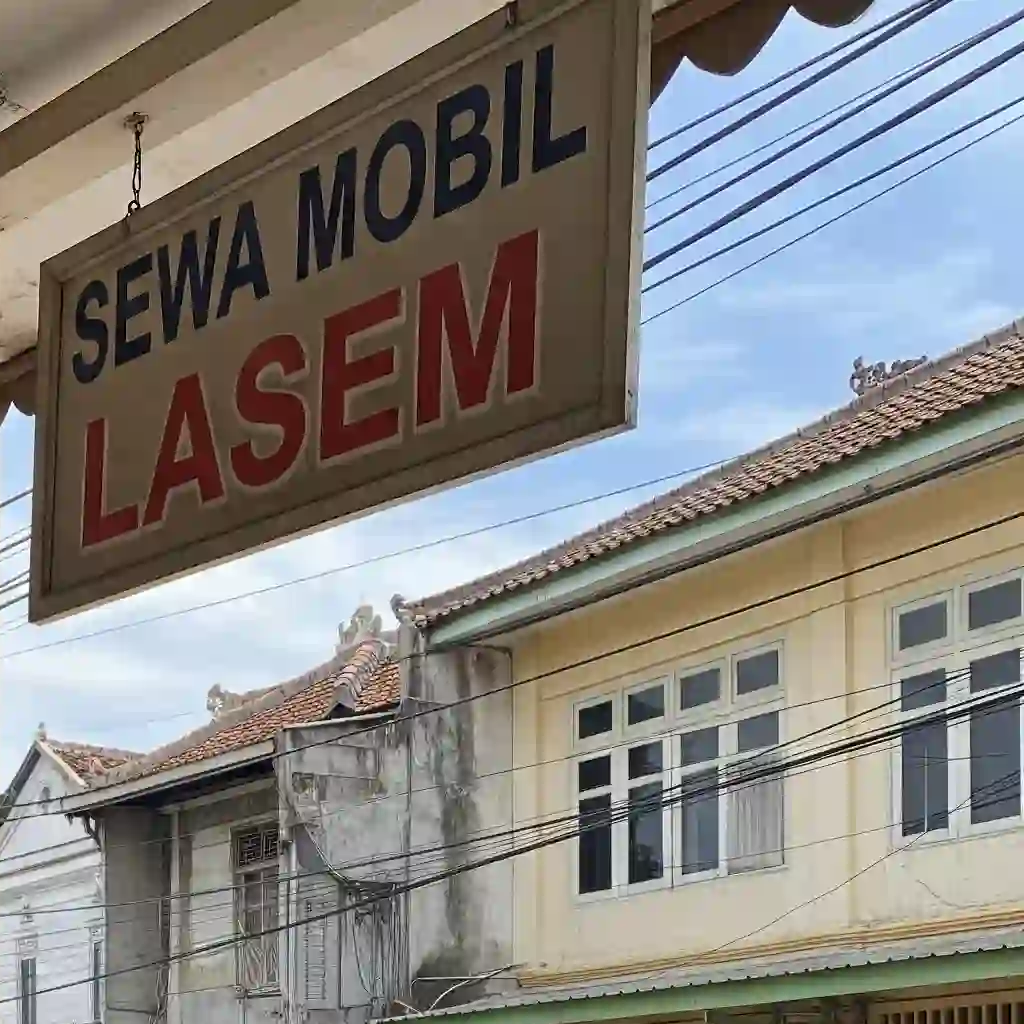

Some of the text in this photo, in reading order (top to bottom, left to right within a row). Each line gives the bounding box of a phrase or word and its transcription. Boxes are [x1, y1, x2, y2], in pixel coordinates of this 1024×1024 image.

[72, 44, 587, 385] SEWA MOBIL
[81, 228, 541, 549] LASEM
